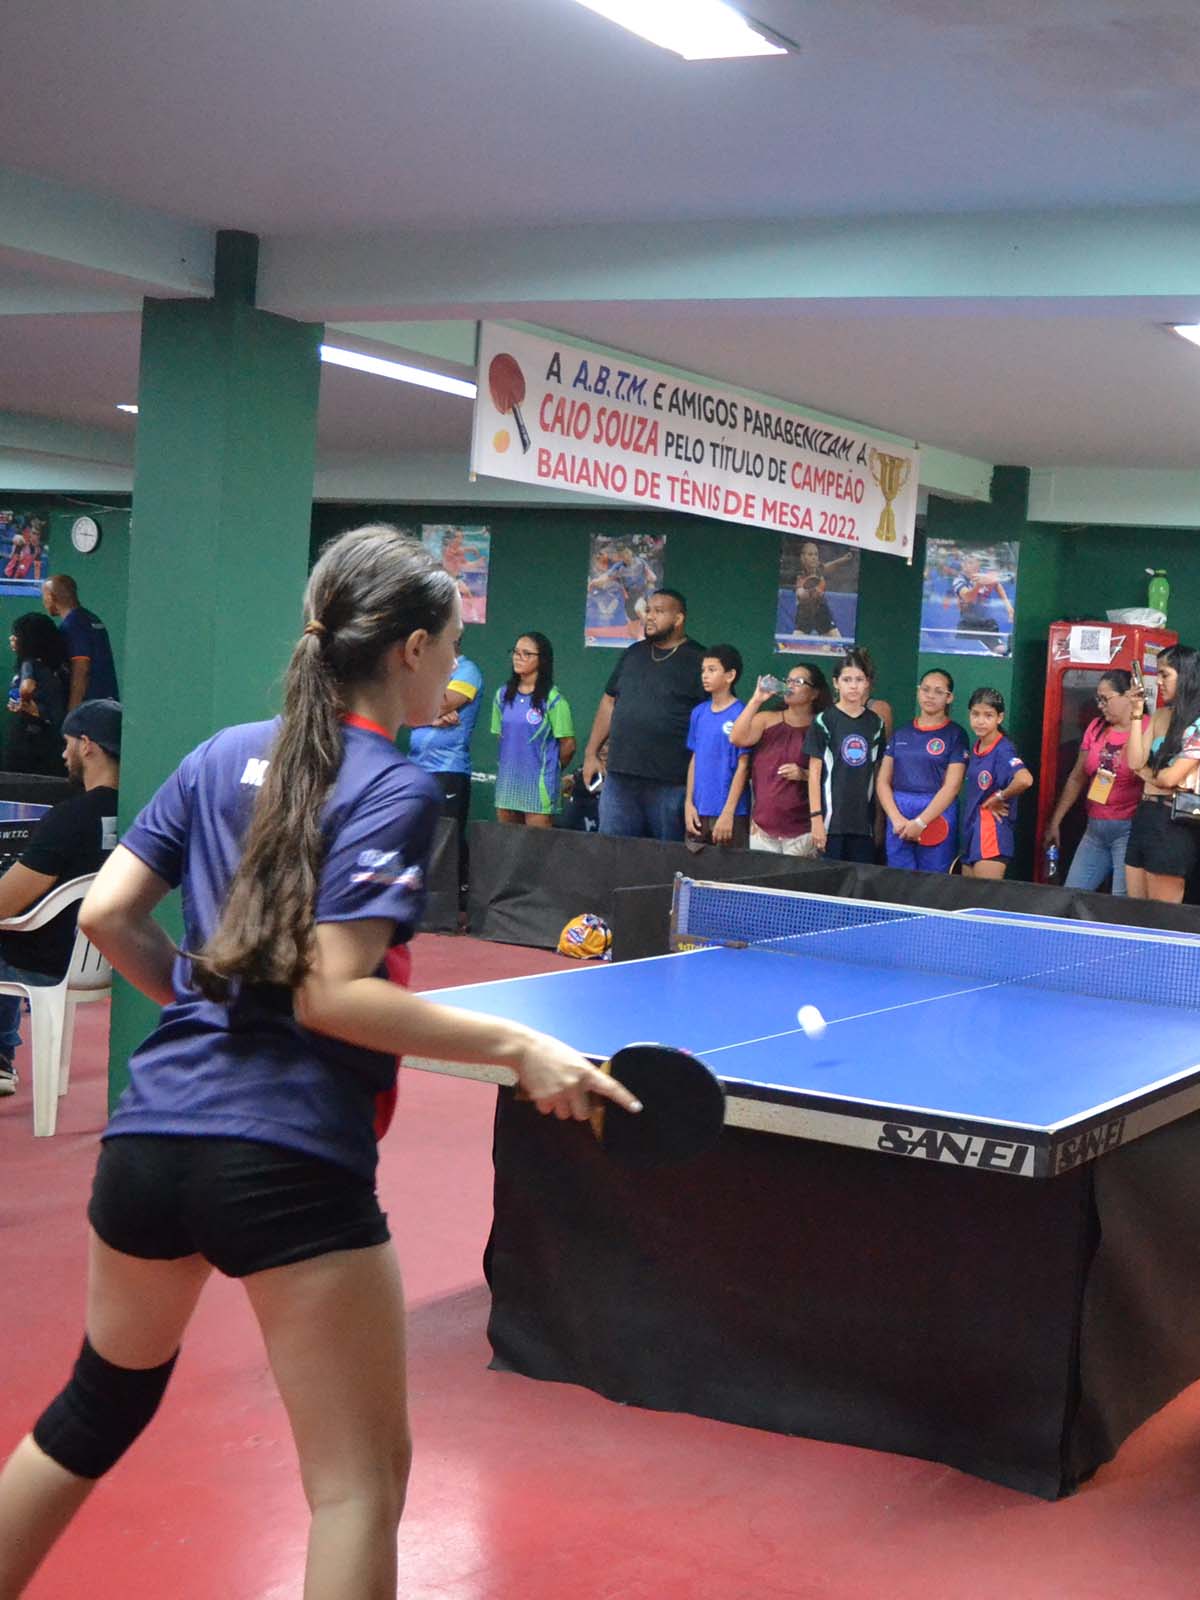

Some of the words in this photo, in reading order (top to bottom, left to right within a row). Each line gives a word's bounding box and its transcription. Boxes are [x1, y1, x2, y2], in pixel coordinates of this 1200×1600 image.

[539, 392, 592, 441] CAIO
[593, 406, 660, 457] SOUZA
[664, 430, 705, 465] PELO
[709, 435, 764, 479] TÍTULO
[768, 456, 787, 485] DE
[790, 461, 865, 505] CAMPEÃO
[546, 351, 562, 384] A
[572, 359, 648, 406] A.B.T.M.
[653, 382, 667, 411] E
[668, 386, 738, 430] AMIGOS
[743, 406, 856, 462] PARABENIZAM
[856, 442, 868, 467] A
[537, 447, 628, 493] BAIANO
[633, 467, 662, 500] DE
[666, 469, 722, 512] TÊNIS
[722, 488, 757, 519] DE
[761, 496, 815, 532] MESA
[818, 511, 860, 542] 2022.
[877, 1122, 1030, 1175] SAN-EI
[1059, 1117, 1127, 1170] SAN-EI
